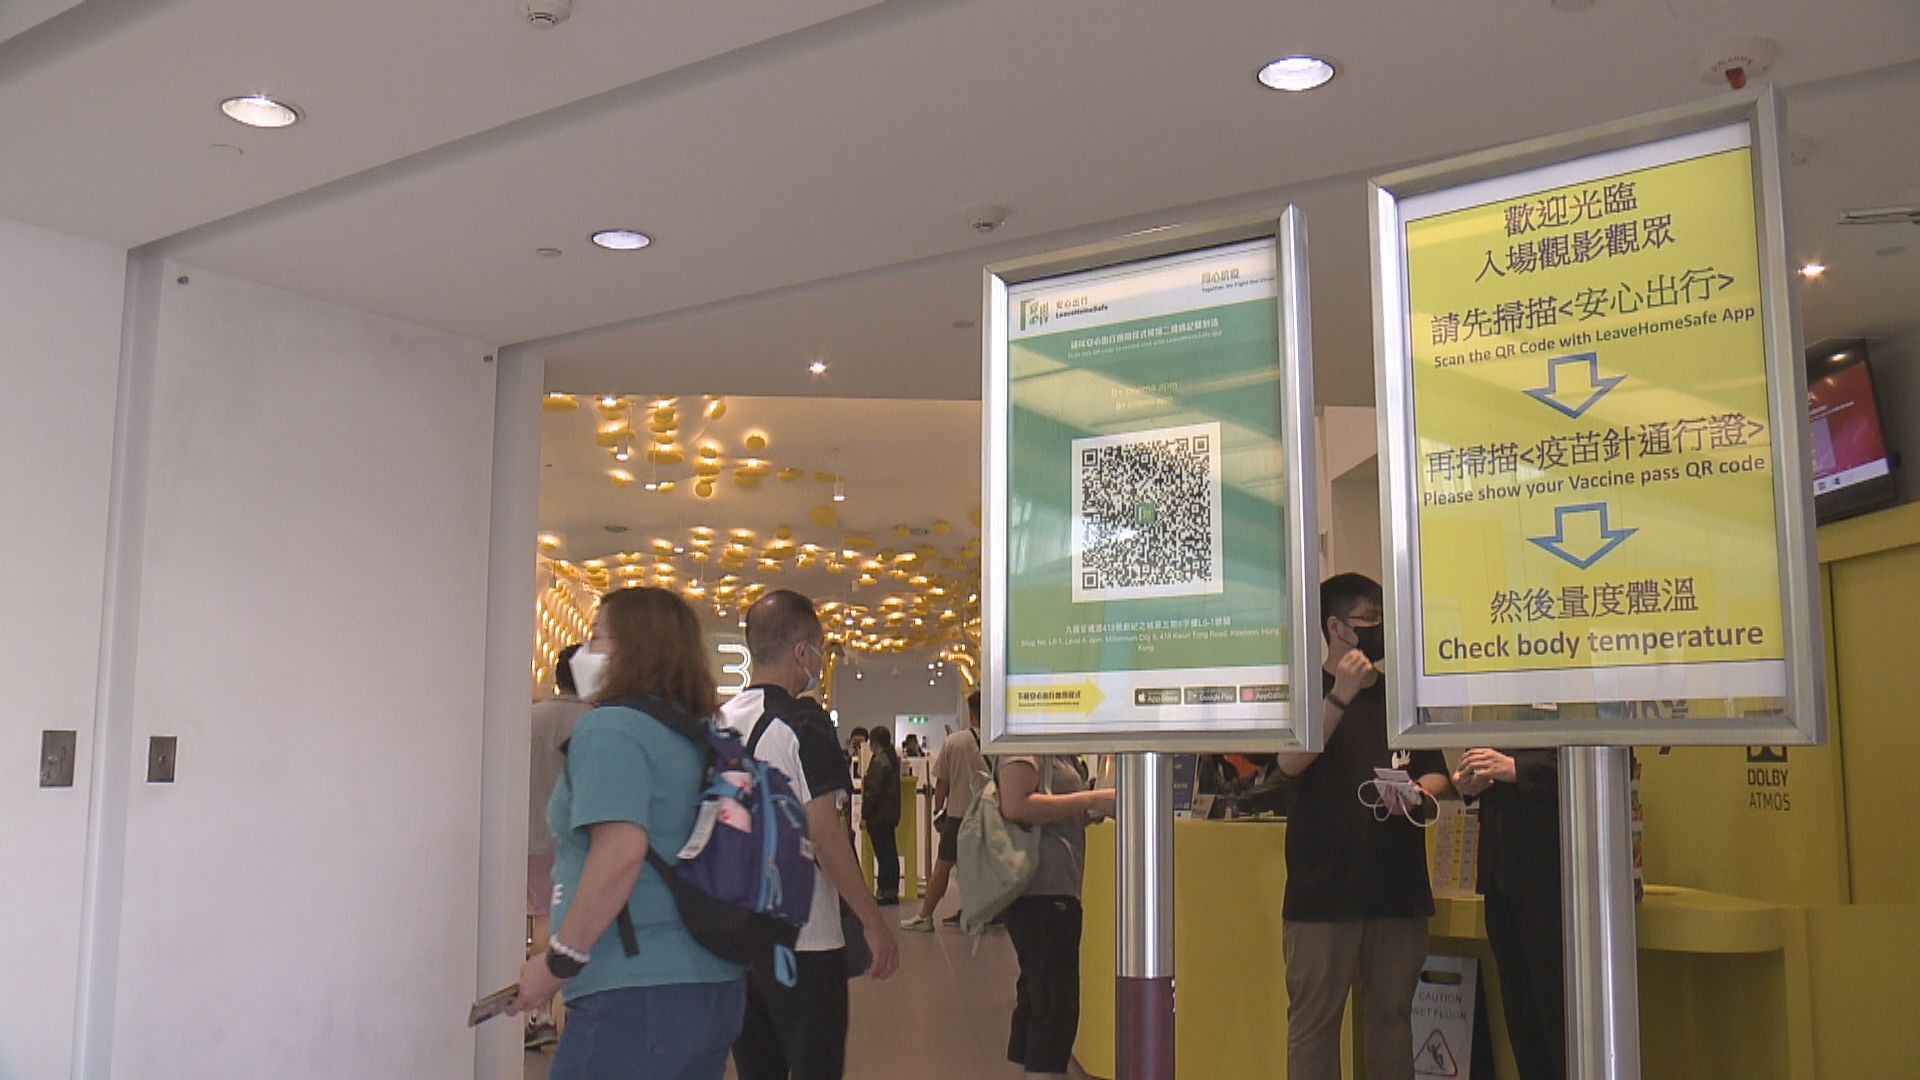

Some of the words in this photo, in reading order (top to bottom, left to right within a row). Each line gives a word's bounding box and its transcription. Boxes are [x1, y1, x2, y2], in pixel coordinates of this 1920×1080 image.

[1503, 181, 1638, 238] 歡迎光臨
[1474, 214, 1676, 283] 入場觀影觀眾
[1430, 266, 1735, 346] 請先掃描<安心出行>
[1434, 354, 1465, 369] Scan
[1469, 350, 1491, 364] the
[1495, 344, 1516, 361] QR
[1520, 338, 1556, 354] Code
[1559, 331, 1592, 349] with
[1596, 311, 1718, 343] LeaveHomeSafe
[1723, 306, 1755, 324] App
[1425, 412, 1765, 483] 再掃描<疫苗針通行證>
[1424, 490, 1473, 507] Please
[1478, 482, 1521, 501] show
[1526, 478, 1564, 499] your
[1568, 470, 1635, 491] Vaccine
[1641, 468, 1680, 488] pass
[1685, 461, 1714, 480] QR
[1719, 455, 1766, 474] code
[1489, 576, 1699, 625] 然後量度體溫
[1439, 637, 1511, 661] Check
[1517, 631, 1581, 660] body
[1587, 625, 1765, 656] temperature
[1747, 768, 1788, 787] DOLBY
[1749, 792, 1791, 811] ATMOS
[1418, 991, 1463, 1004] CAUTION
